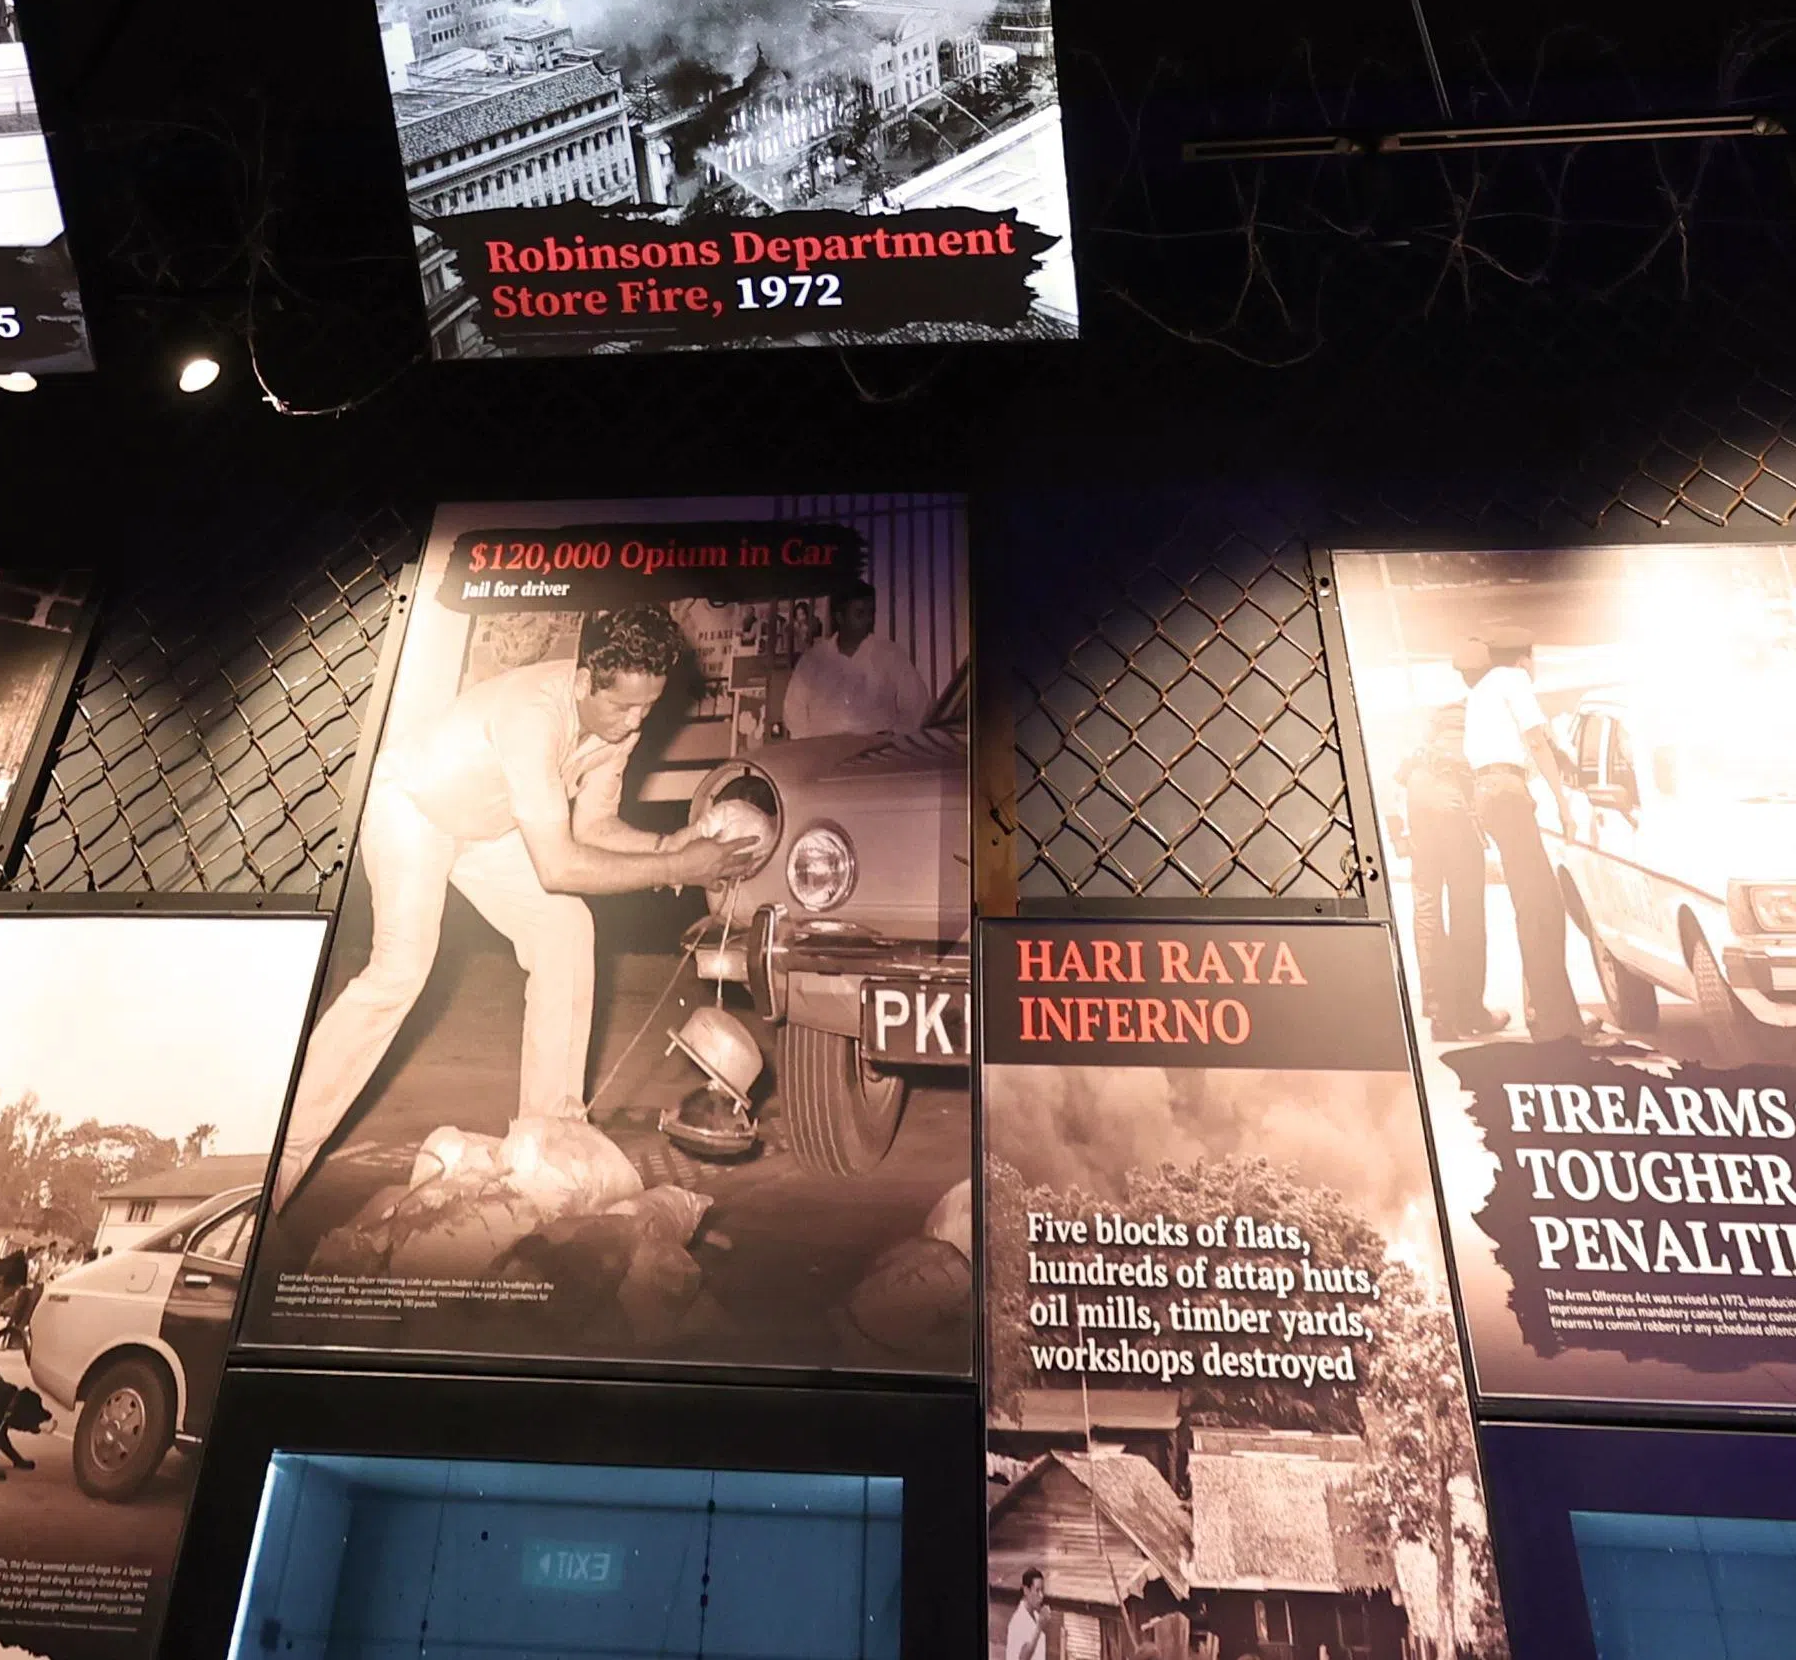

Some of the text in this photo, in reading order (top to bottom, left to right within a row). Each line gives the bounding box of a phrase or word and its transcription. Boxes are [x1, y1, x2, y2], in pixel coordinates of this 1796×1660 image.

[486, 221, 1015, 274] Robinsons Department
[492, 273, 843, 318] Store Fire, 1972
[469, 539, 838, 574] $120,000 Opium in Car
[462, 581, 570, 599] Jail for driver
[1017, 939, 1308, 987] HARI RAYA
[875, 990, 970, 1054] PK
[1019, 997, 1251, 1044] INFERNO
[1027, 1213, 1311, 1255] Five blocks of flats,
[1029, 1255, 1382, 1300] hundreds of attap huts,
[1545, 1288, 1564, 1301] The
[1565, 1289, 1592, 1302] Arms
[1592, 1290, 1634, 1303] Offences
[1635, 1292, 1652, 1304] Act
[1652, 1294, 1672, 1304] was
[1673, 1293, 1708, 1306] revised
[1708, 1294, 1720, 1305] in
[1030, 1295, 1375, 1344] oil mills, timber yards,
[1548, 1303, 1615, 1317] imprisonment
[1615, 1305, 1637, 1319] plus
[1638, 1307, 1689, 1321] mandatory
[1690, 1308, 1723, 1323] caning
[1723, 1309, 1738, 1321] for
[1739, 1309, 1767, 1322] those
[1551, 1316, 1593, 1330] firearms
[1593, 1319, 1604, 1330] to
[1605, 1319, 1642, 1331] commit
[1642, 1321, 1680, 1335] robbery
[1681, 1323, 1693, 1333] or
[1694, 1324, 1712, 1337] any
[1713, 1323, 1763, 1336] scheduled
[1031, 1341, 1356, 1387] workshops destroyed
